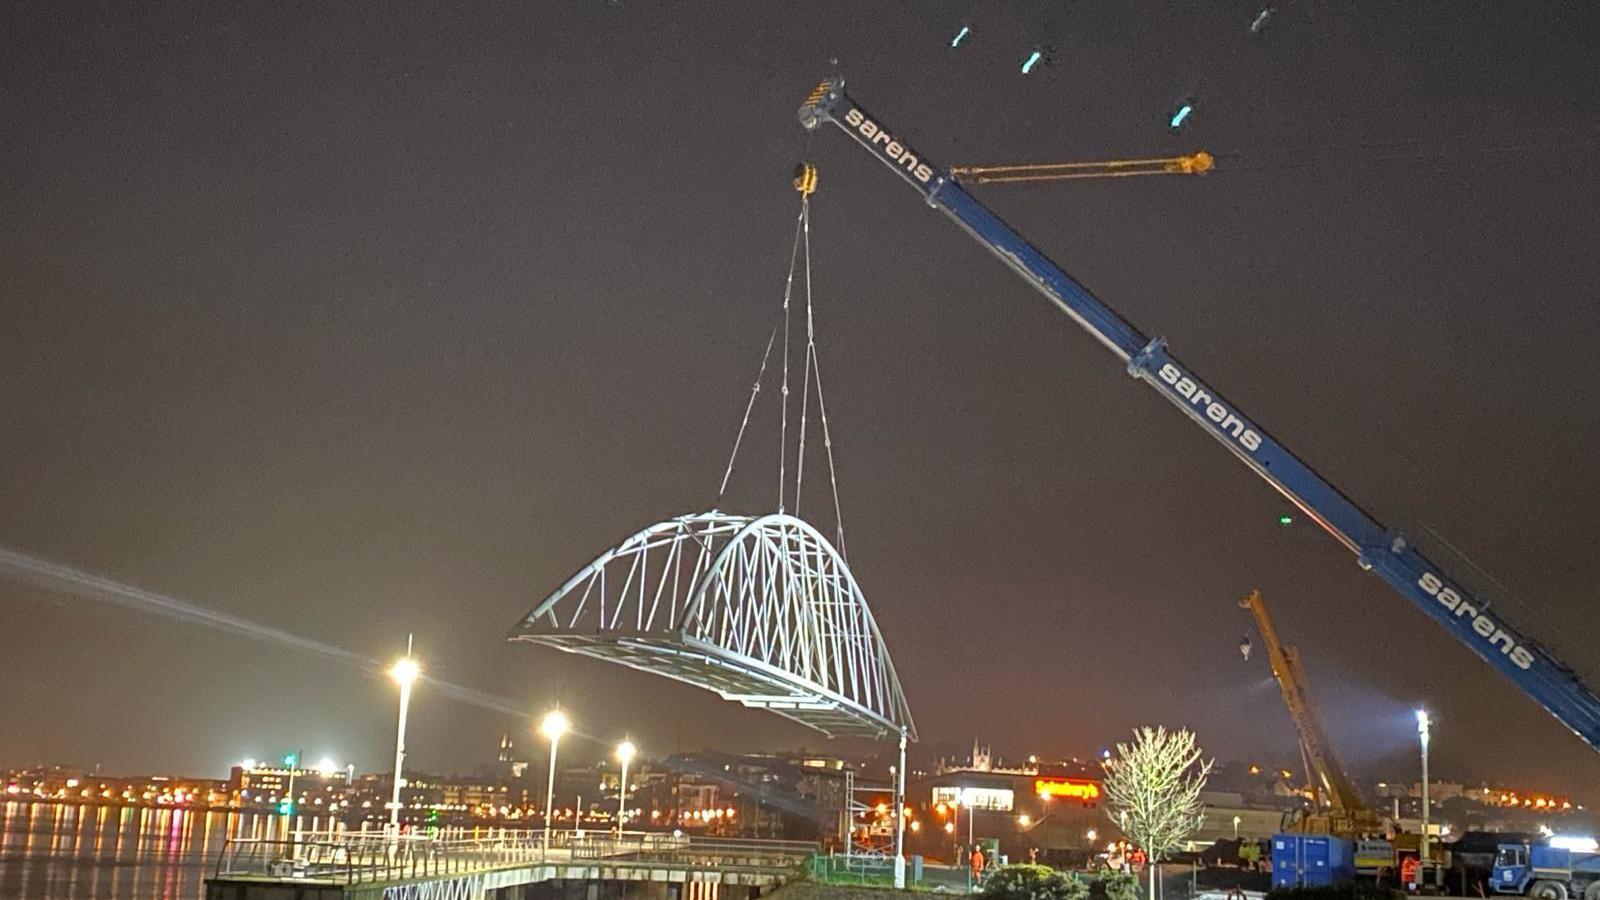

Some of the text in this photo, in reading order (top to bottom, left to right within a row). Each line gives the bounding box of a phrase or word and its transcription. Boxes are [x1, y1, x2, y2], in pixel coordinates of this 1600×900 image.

[845, 108, 933, 182] sarens
[1158, 363, 1262, 451] sarens
[1417, 572, 1535, 670] sarens
